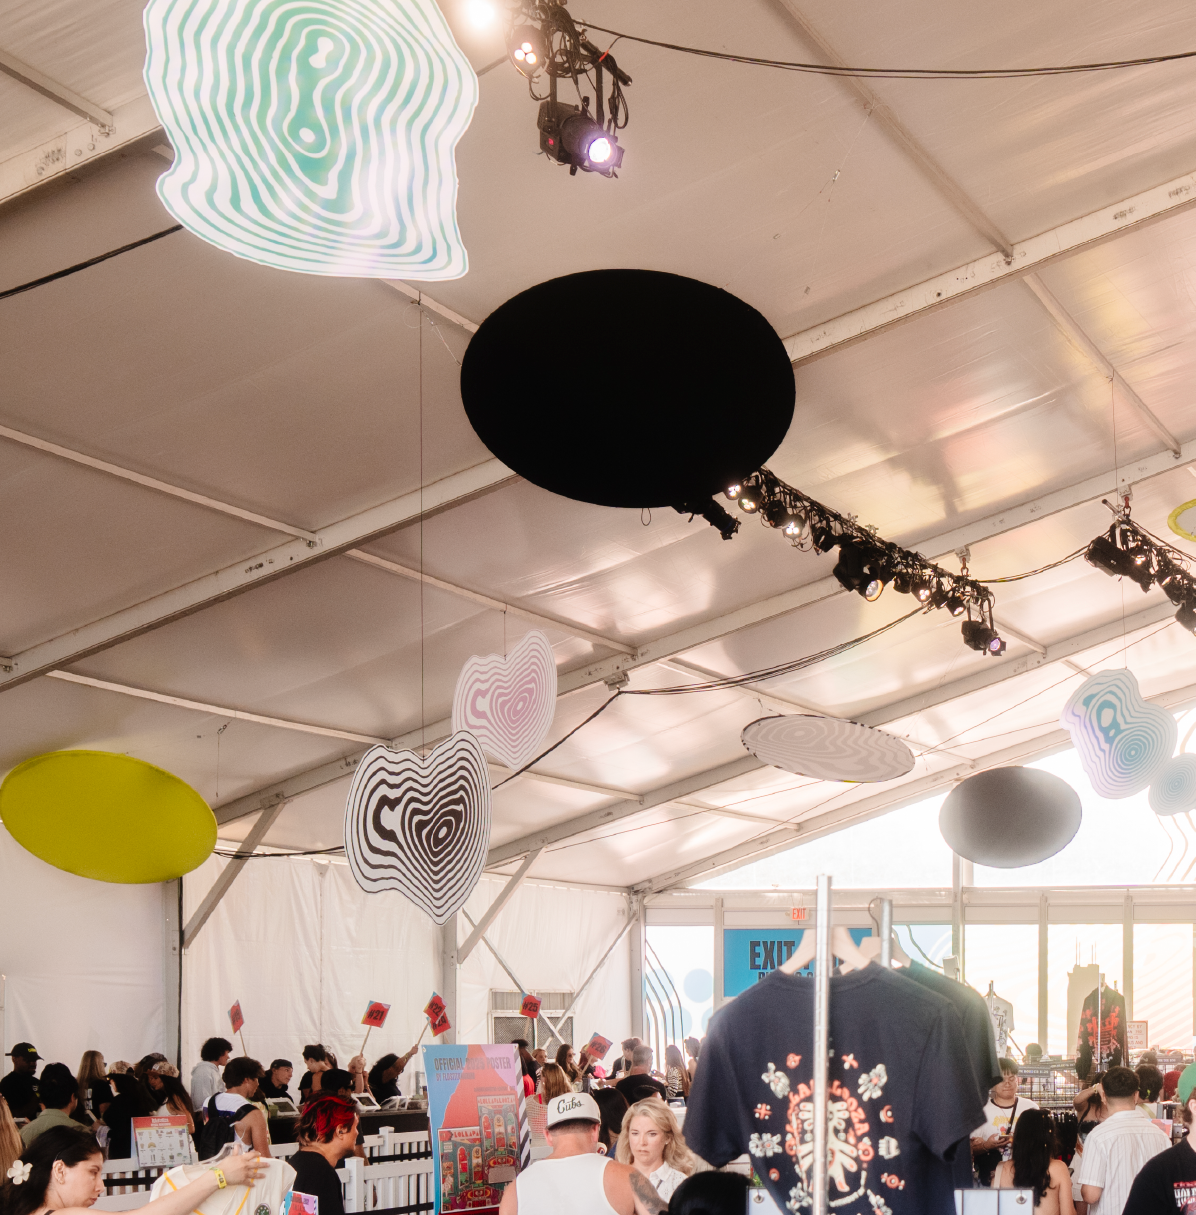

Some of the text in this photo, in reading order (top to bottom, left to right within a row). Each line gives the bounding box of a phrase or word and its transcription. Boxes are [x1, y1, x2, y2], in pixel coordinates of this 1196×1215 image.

[792, 908, 807, 920] EXIT
[749, 940, 796, 970] EXIT
[429, 1001, 443, 1017] #22
[522, 1001, 538, 1013] #25
[367, 1010, 384, 1021] #21
[434, 1057, 464, 1071] OFFICIAL
[486, 1056, 512, 1070] POSTER
[556, 1098, 585, 1114] Cubs
[454, 1130, 479, 1138] LOLLAPA
